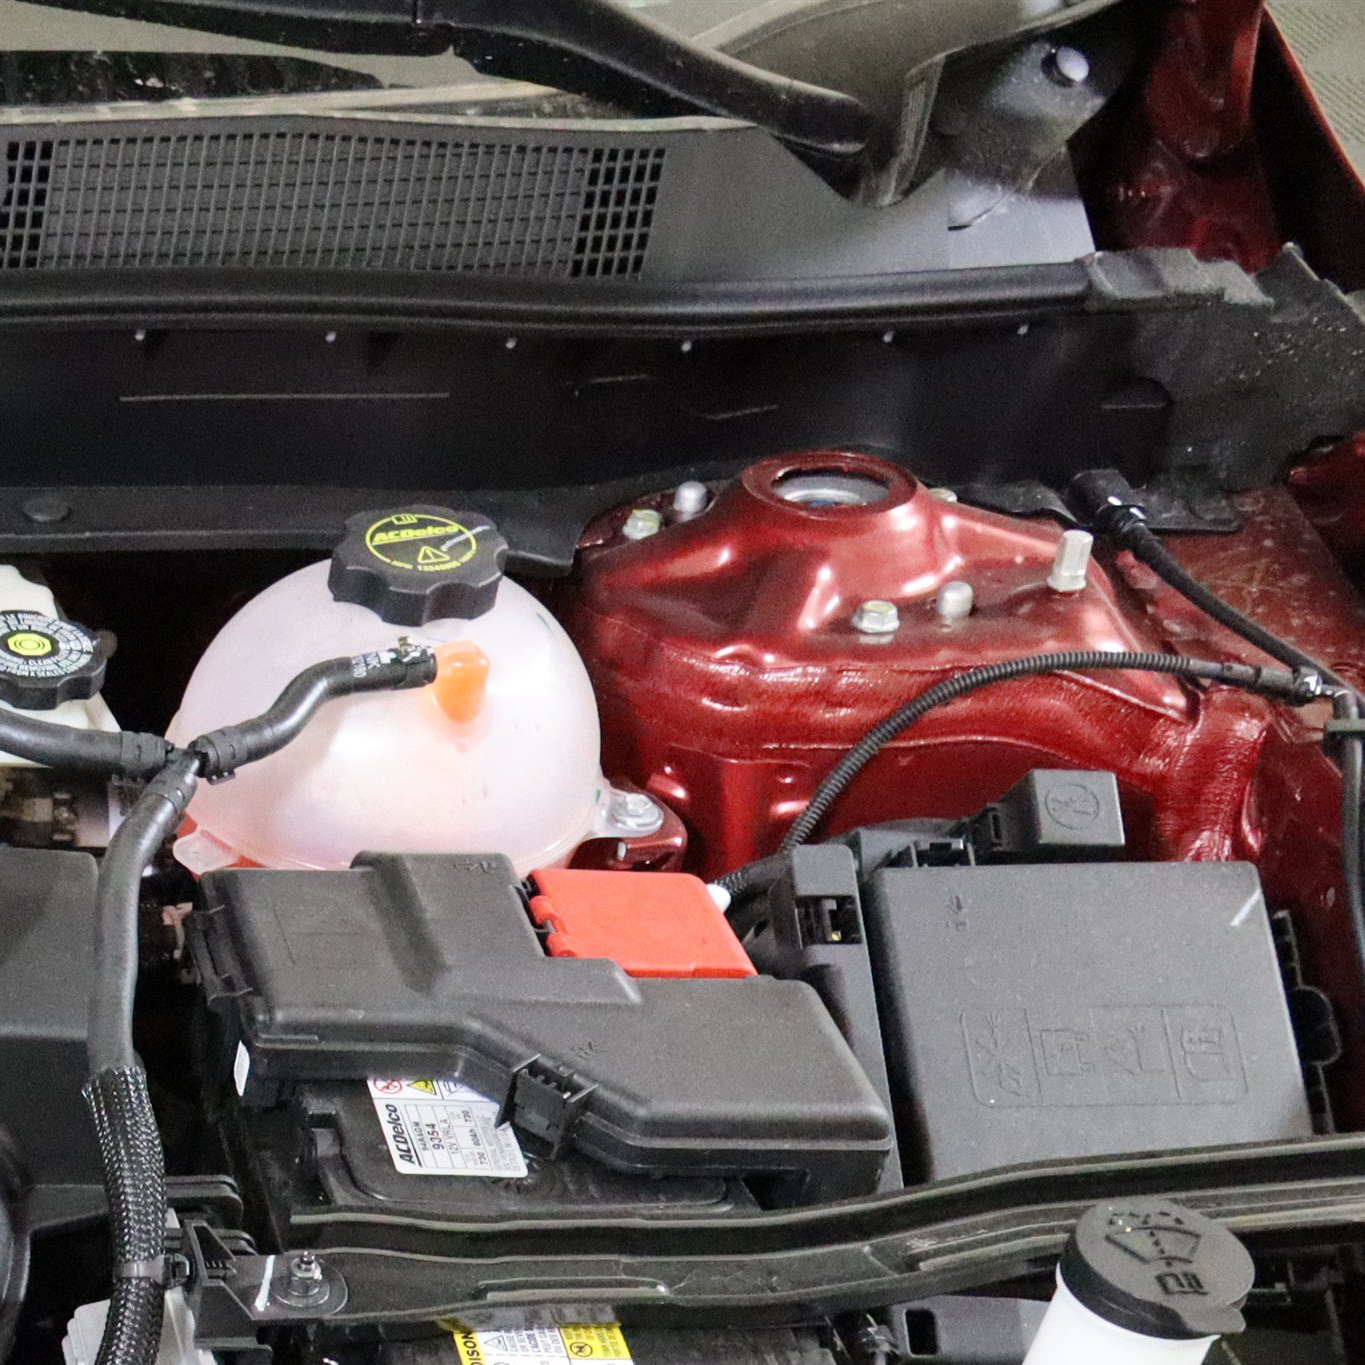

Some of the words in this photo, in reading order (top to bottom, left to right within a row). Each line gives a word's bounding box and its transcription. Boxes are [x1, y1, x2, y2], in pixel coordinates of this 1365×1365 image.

[373, 525, 459, 543] ACDelco
[385, 1104, 416, 1165] ACDelco
[425, 1123, 444, 1150] 9354
